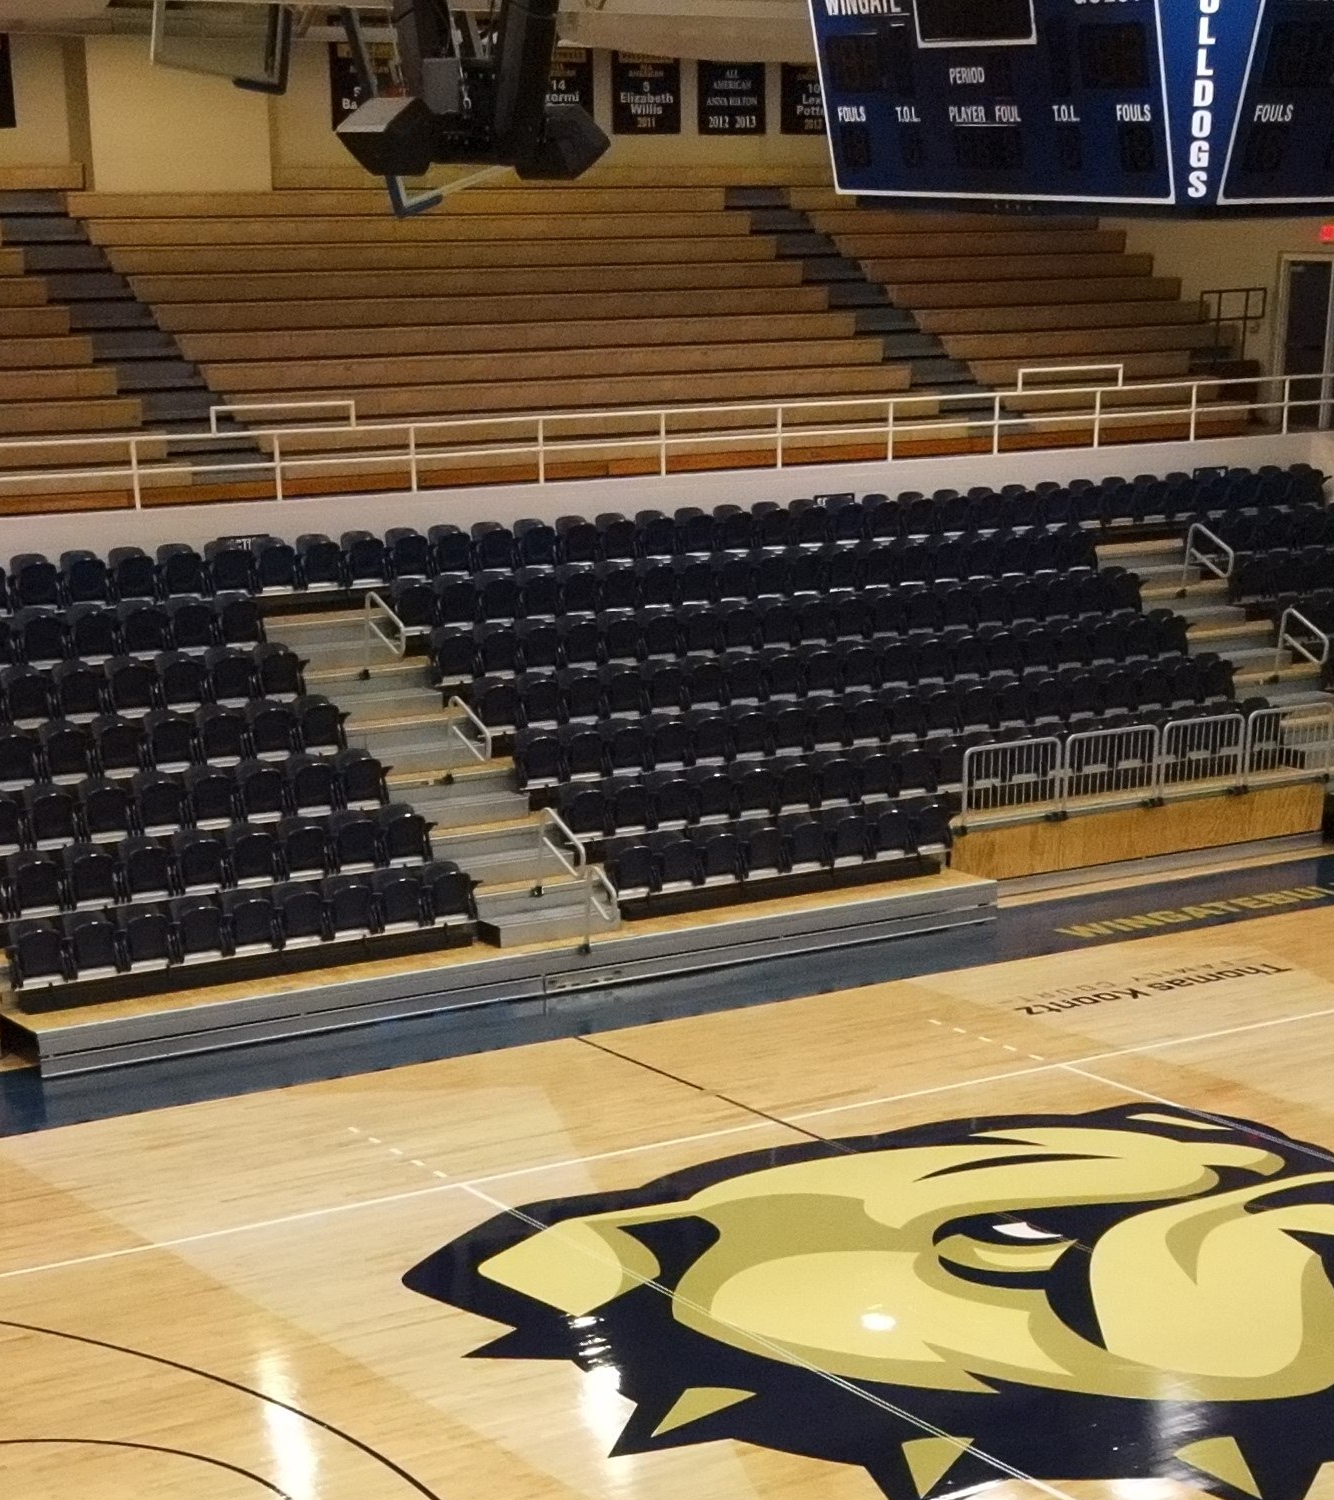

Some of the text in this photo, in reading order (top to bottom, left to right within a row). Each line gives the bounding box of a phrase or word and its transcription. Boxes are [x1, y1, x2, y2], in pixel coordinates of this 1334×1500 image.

[949, 67, 985, 84] PERIOD
[551, 80, 566, 91] 14
[620, 92, 674, 103] Elizabeth
[631, 103, 663, 115] Willis
[837, 106, 867, 122] FOULS
[949, 105, 1022, 123] PLAYER FOUL
[1116, 104, 1151, 122] FOULS
[1254, 105, 1293, 123] FOULS
[1014, 962, 1293, 1016] Thomas Koontz
